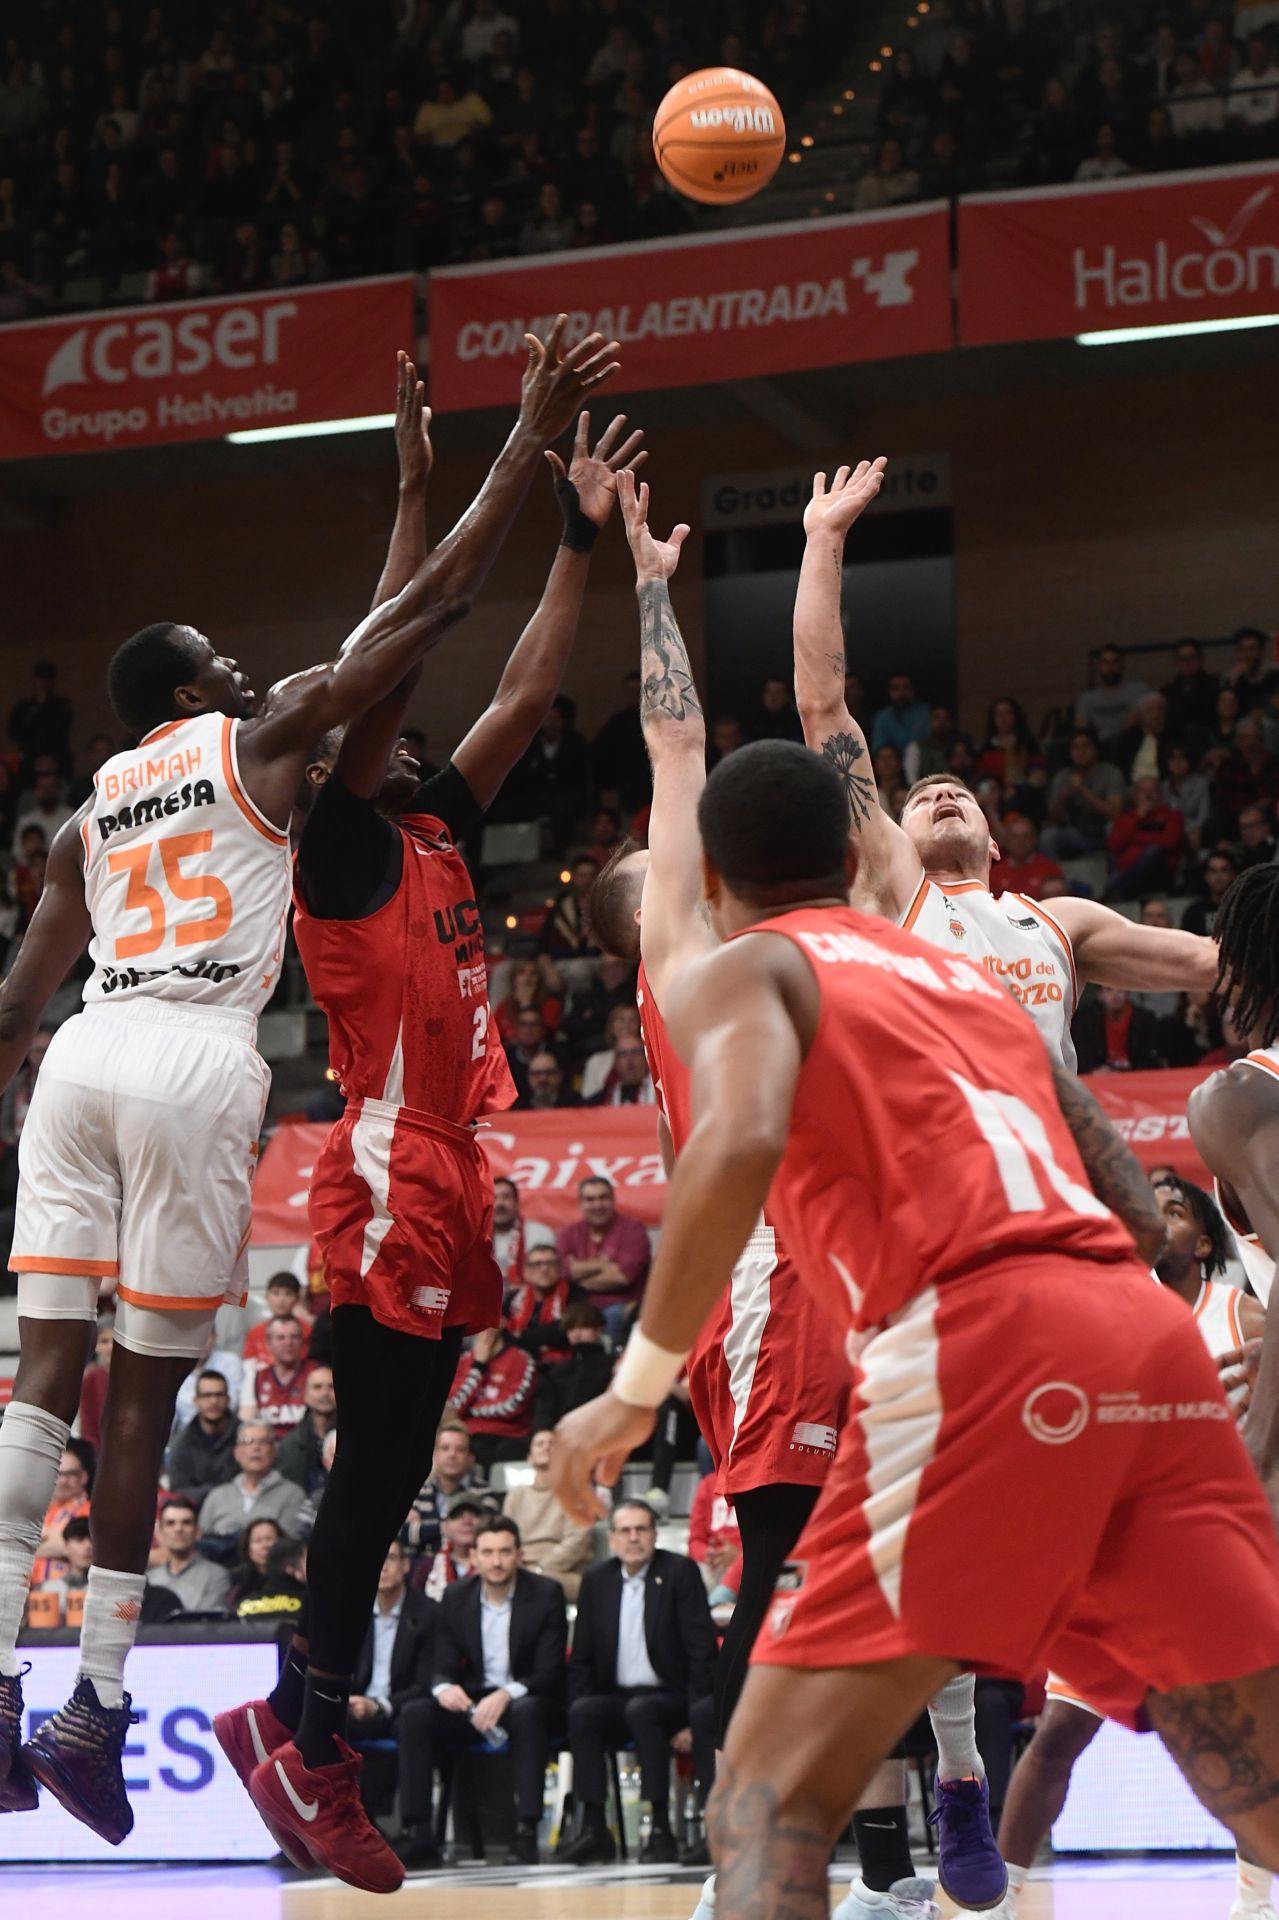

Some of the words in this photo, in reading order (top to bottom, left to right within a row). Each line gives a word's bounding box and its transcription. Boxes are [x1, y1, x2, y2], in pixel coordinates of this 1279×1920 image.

[92, 303, 298, 383] caser
[42, 406, 148, 442] Grupo
[157, 384, 298, 427] Helvetia
[714, 480, 814, 514] Grad
[105, 746, 201, 801] BRIMAH
[97, 779, 216, 840] PAMESA
[107, 829, 233, 960] 35
[433, 899, 482, 944] UC
[1036, 961, 1055, 976] del
